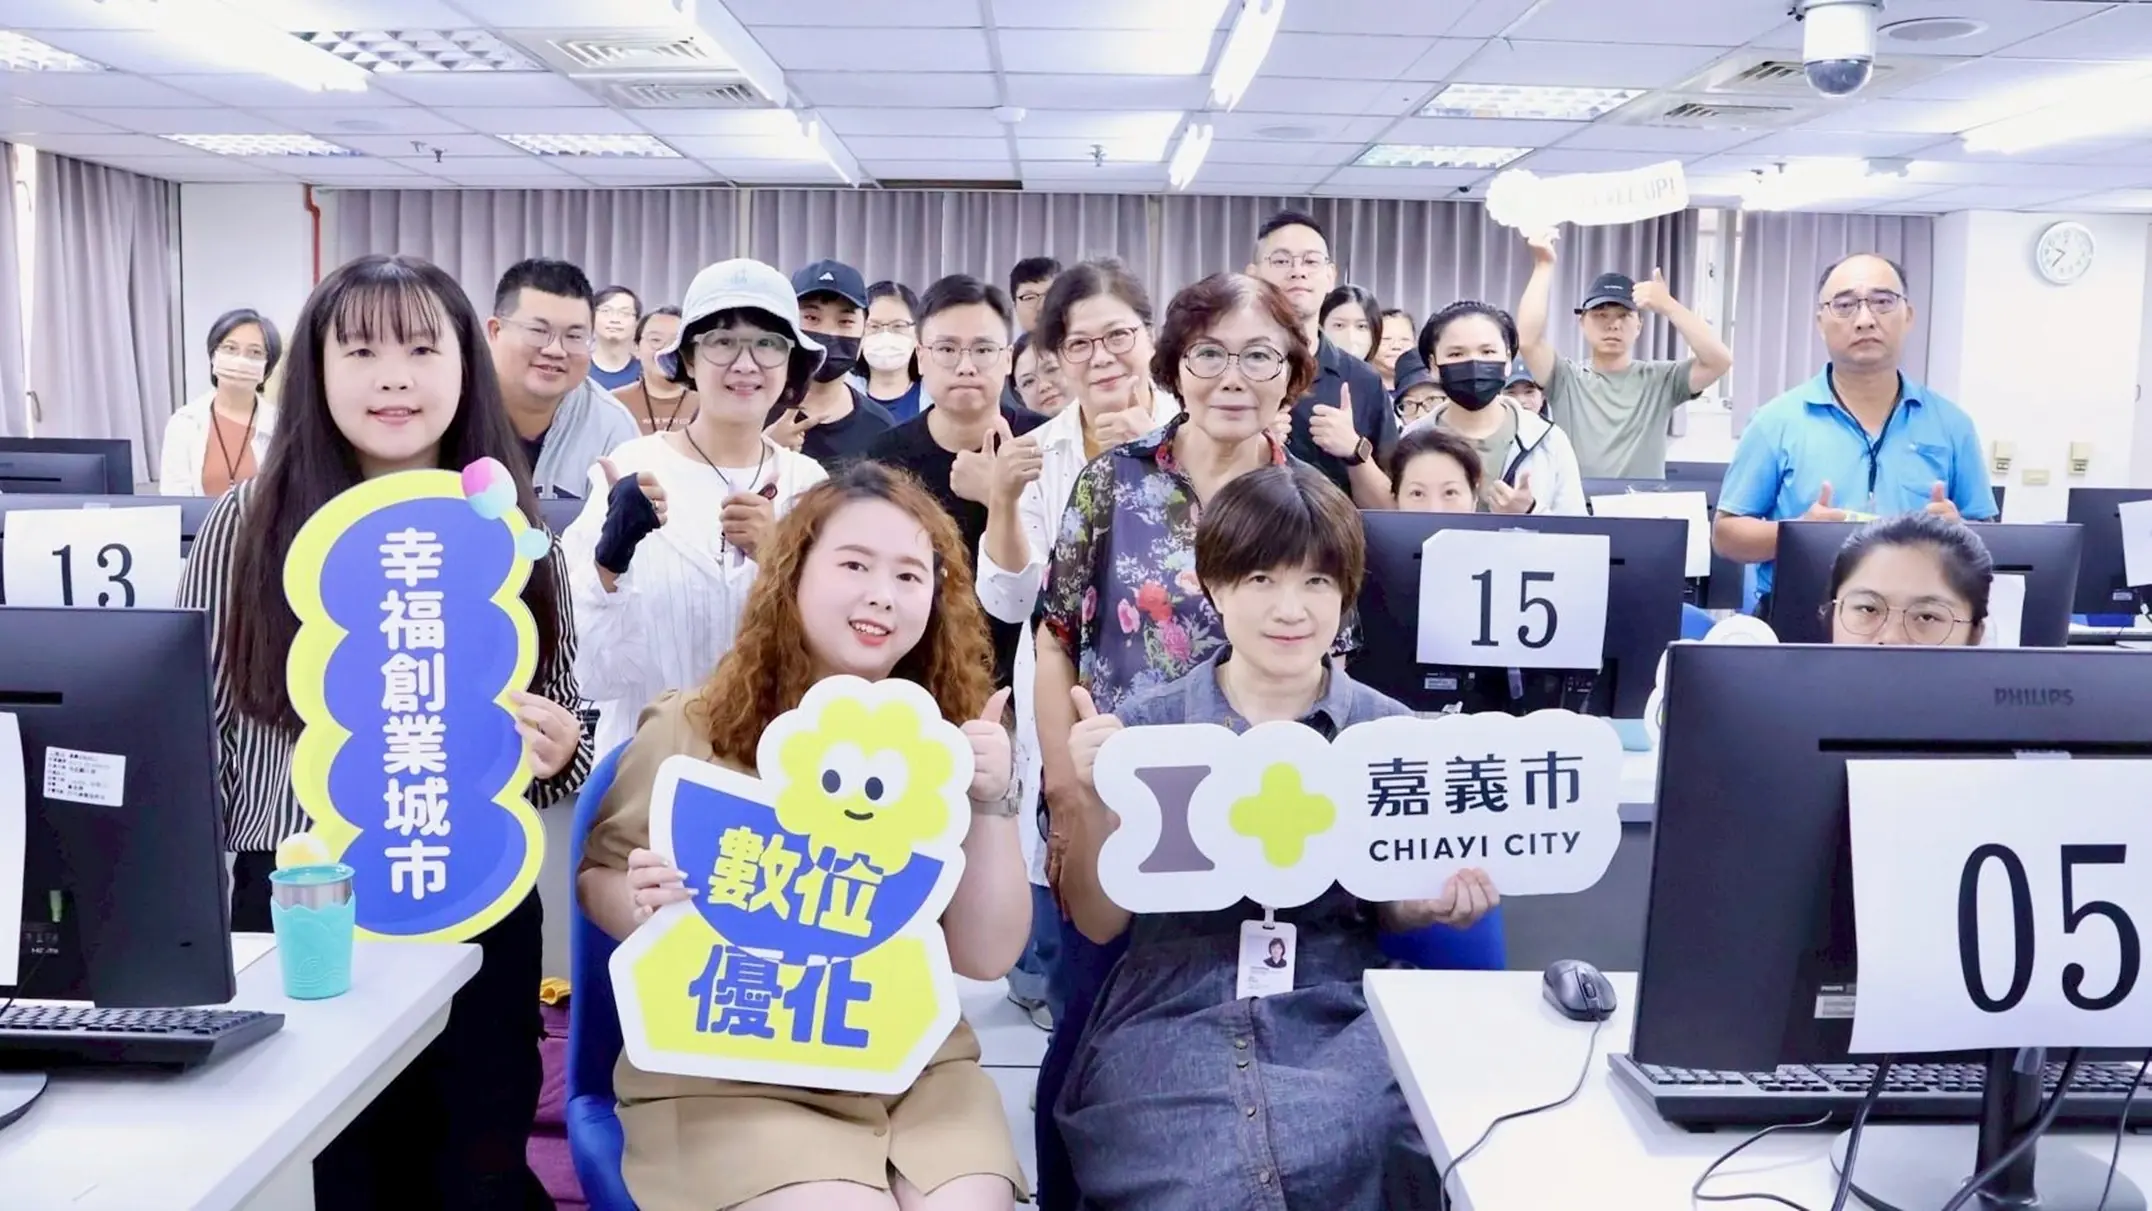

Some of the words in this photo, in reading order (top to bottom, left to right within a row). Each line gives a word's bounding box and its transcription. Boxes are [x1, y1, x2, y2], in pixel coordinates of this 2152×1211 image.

[52, 543, 135, 607] 13
[1471, 569, 1558, 649] 15
[378, 527, 451, 901] 幸福創業城市
[1994, 687, 2075, 706] PHILIPS
[1367, 750, 1584, 817] 嘉義市
[708, 825, 883, 938] 數位
[1369, 835, 1489, 862] CHIAYI
[1505, 831, 1581, 857] CITY
[1957, 843, 2142, 1014] 05
[689, 943, 872, 1048] 優化
